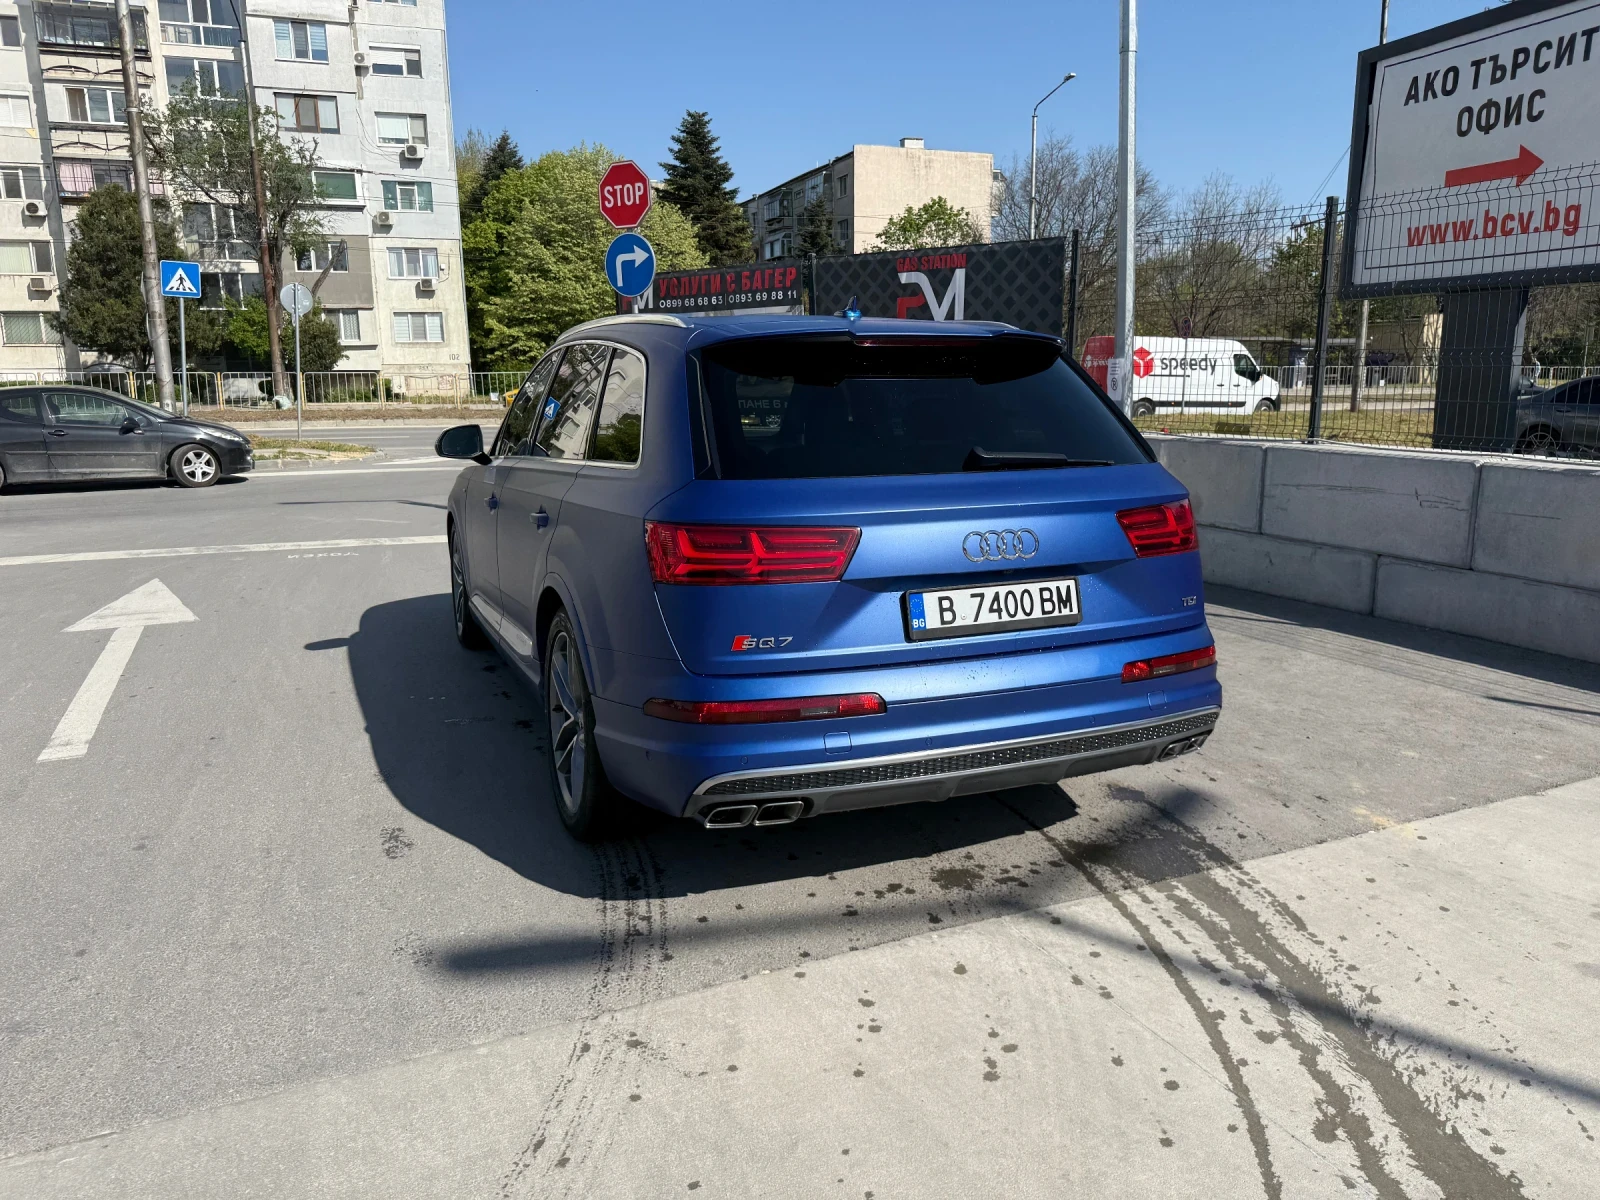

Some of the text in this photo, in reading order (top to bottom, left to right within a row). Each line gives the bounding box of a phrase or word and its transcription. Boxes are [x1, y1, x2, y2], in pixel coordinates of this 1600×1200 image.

[1403, 25, 1600, 107] АКО ТЪРСИТ
[1456, 88, 1547, 138] ОФИС
[603, 181, 644, 208] STOP
[1406, 199, 1582, 247] www.bcv.bg
[896, 252, 967, 273] GAS STATION
[658, 273, 721, 298] УСЛУГИ
[741, 266, 797, 291] БАГЕР
[659, 289, 798, 309] 0899 68 68 63 0893 69 88 11
[448, 353, 461, 361] 102
[1160, 353, 1218, 376] speedy
[937, 584, 1073, 626] B 7400 BM
[912, 618, 925, 628] BG
[741, 635, 795, 649] SQ7
